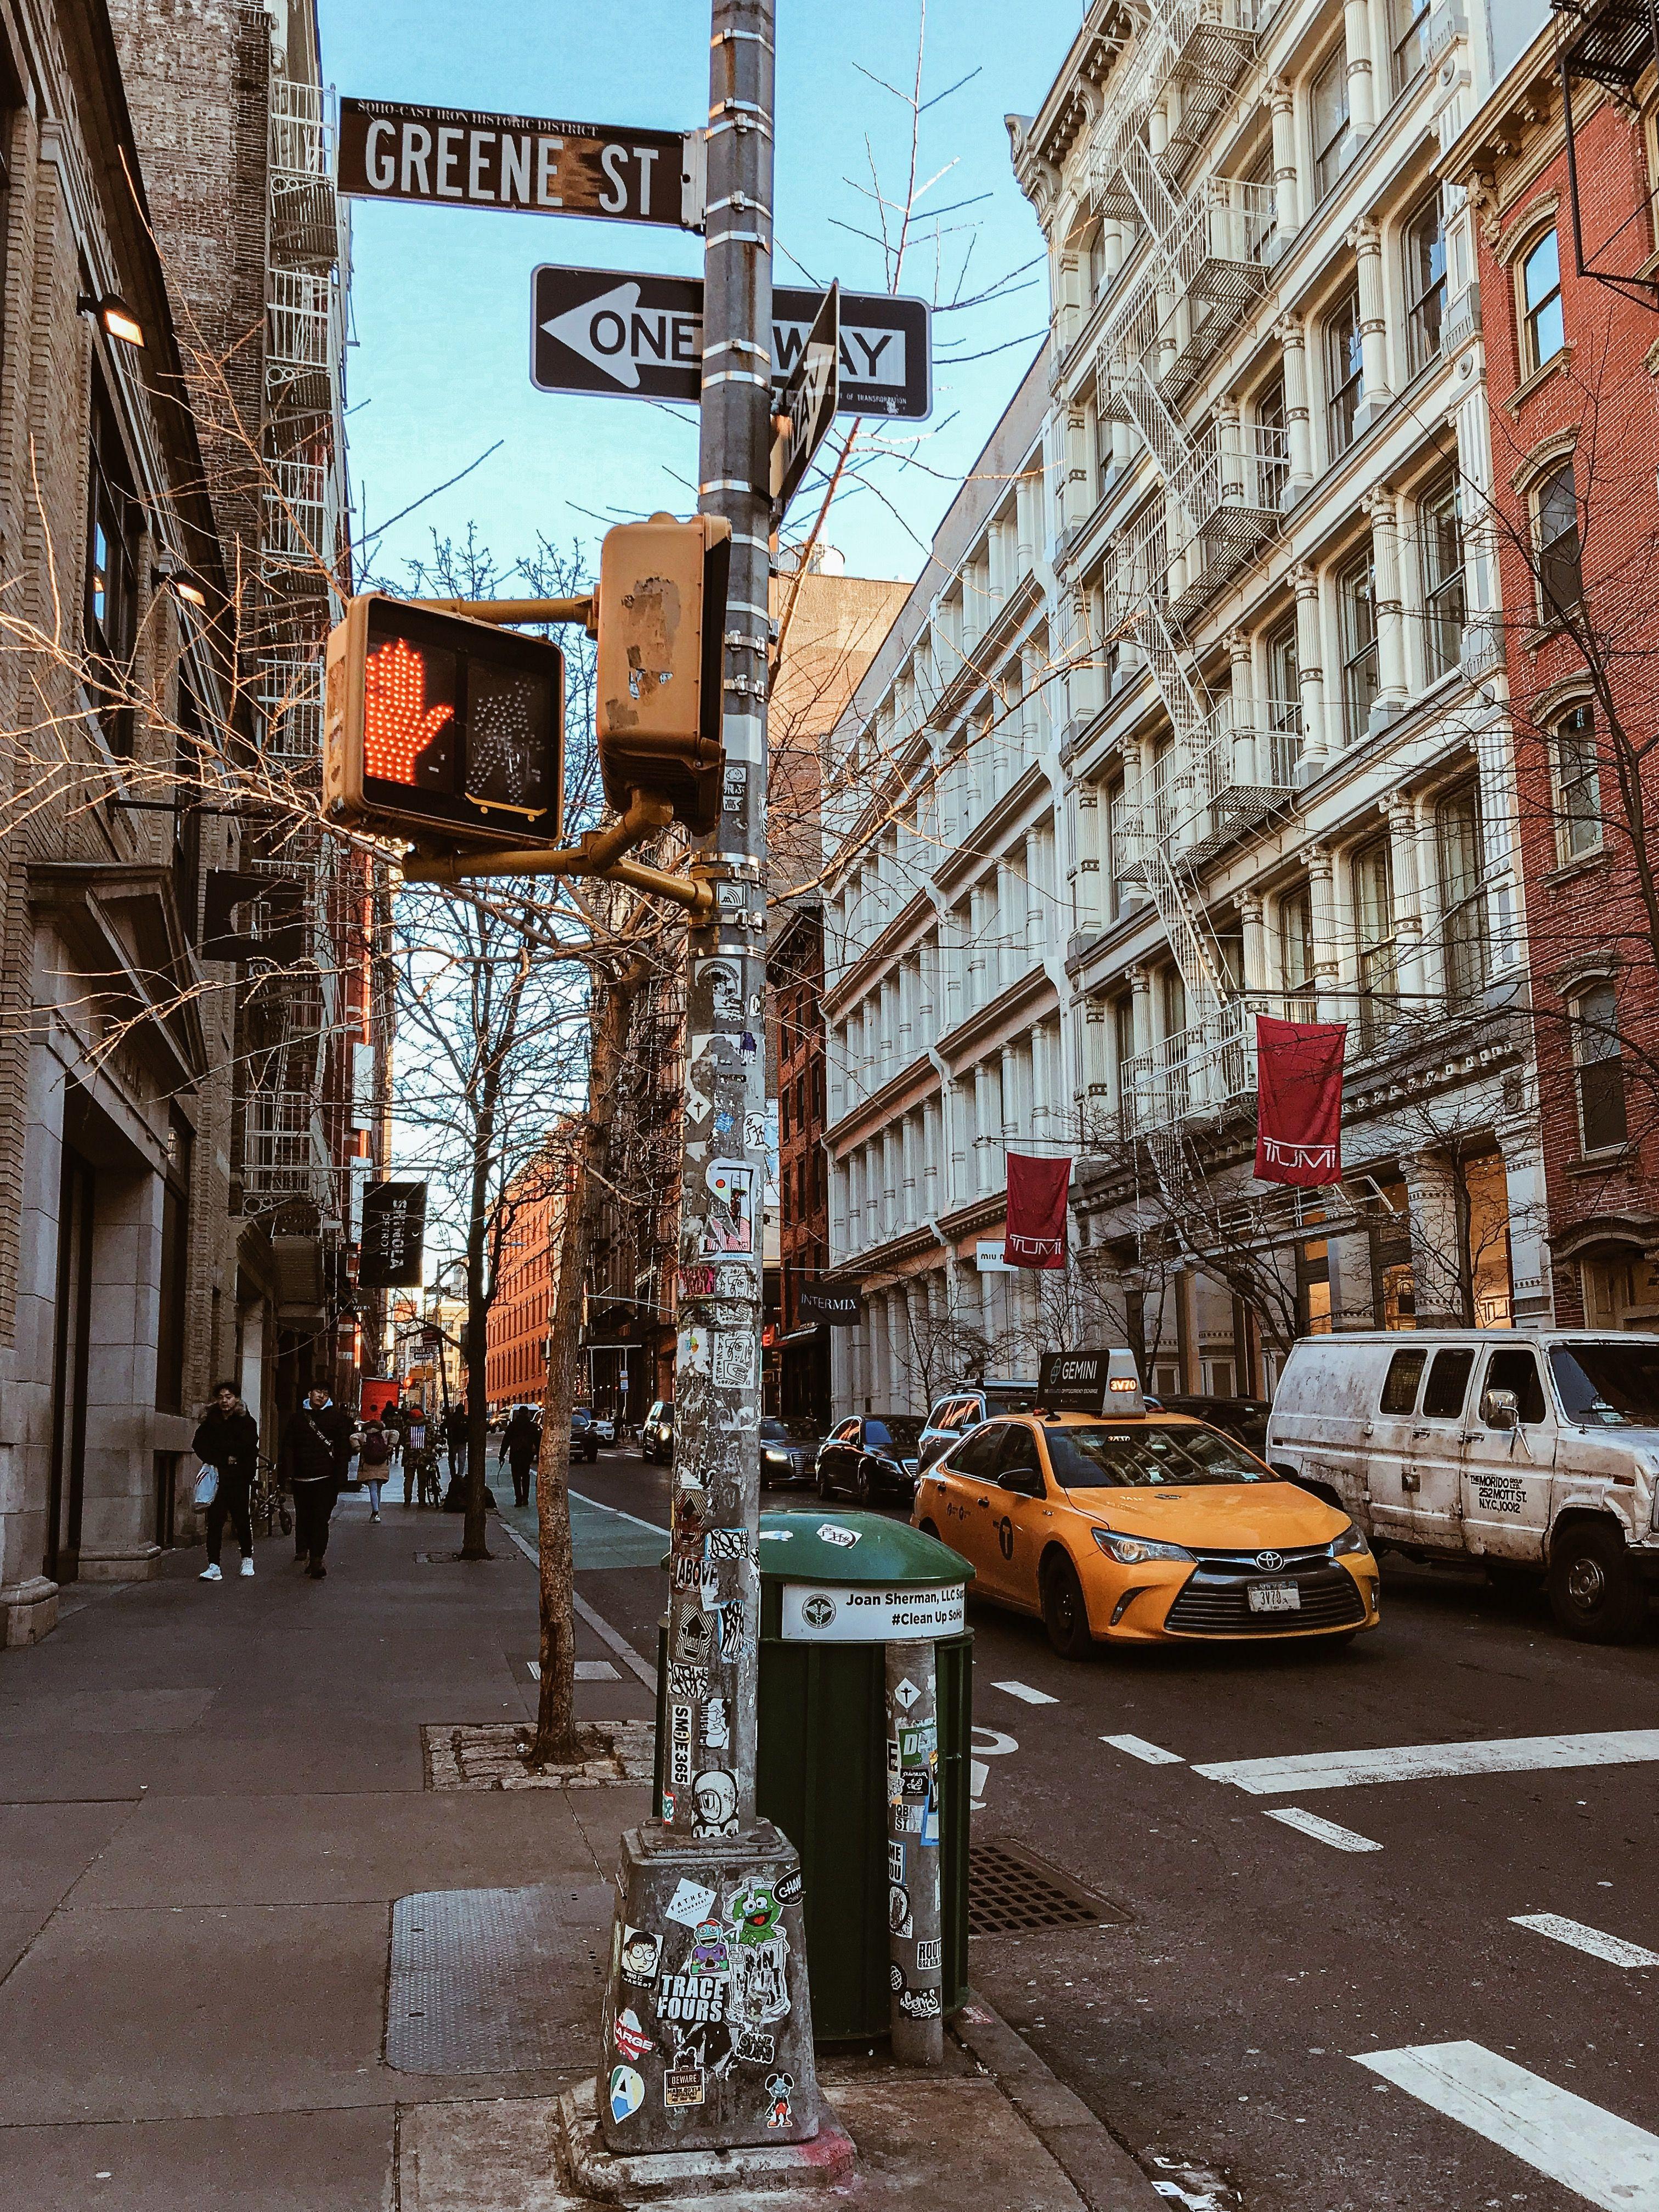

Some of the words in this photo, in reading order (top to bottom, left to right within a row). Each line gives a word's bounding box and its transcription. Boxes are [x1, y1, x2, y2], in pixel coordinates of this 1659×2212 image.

[437, 110, 468, 123] IRON
[471, 112, 534, 129] HISTORIC
[538, 120, 599, 137] DISTRICT
[365, 119, 564, 207] GREENE
[600, 144, 659, 215] ST
[589, 310, 693, 360] ONE
[1263, 1137, 1335, 1168] TUMI
[380, 1214, 390, 1257] DETROT
[1010, 1234, 1061, 1255] TUMI
[802, 1293, 857, 1310] INTERMIX
[1062, 1361, 1097, 1379] GEMINI
[1110, 1380, 1136, 1390] 3V70
[1480, 1475, 1509, 1488] MORIDO
[1479, 1487, 1493, 1498] 252
[1493, 1489, 1515, 1500] MOTT
[1516, 1491, 1527, 1503] ST.
[1499, 1500, 1521, 1514] 10012
[845, 1594, 881, 1606] Joan
[885, 1593, 939, 1605] Sherman,
[941, 1590, 955, 1602] LLC
[892, 1612, 933, 1626] #Clean
[935, 1611, 947, 1624] Up
[949, 1608, 962, 1621] SoHo
[670, 1890, 709, 1911] FATHER
[662, 1974, 724, 2000] TRACE
[657, 1996, 723, 2022] FOURS
[616, 2026, 654, 2051] ARGE
[672, 2074, 697, 2085] BEWARE
